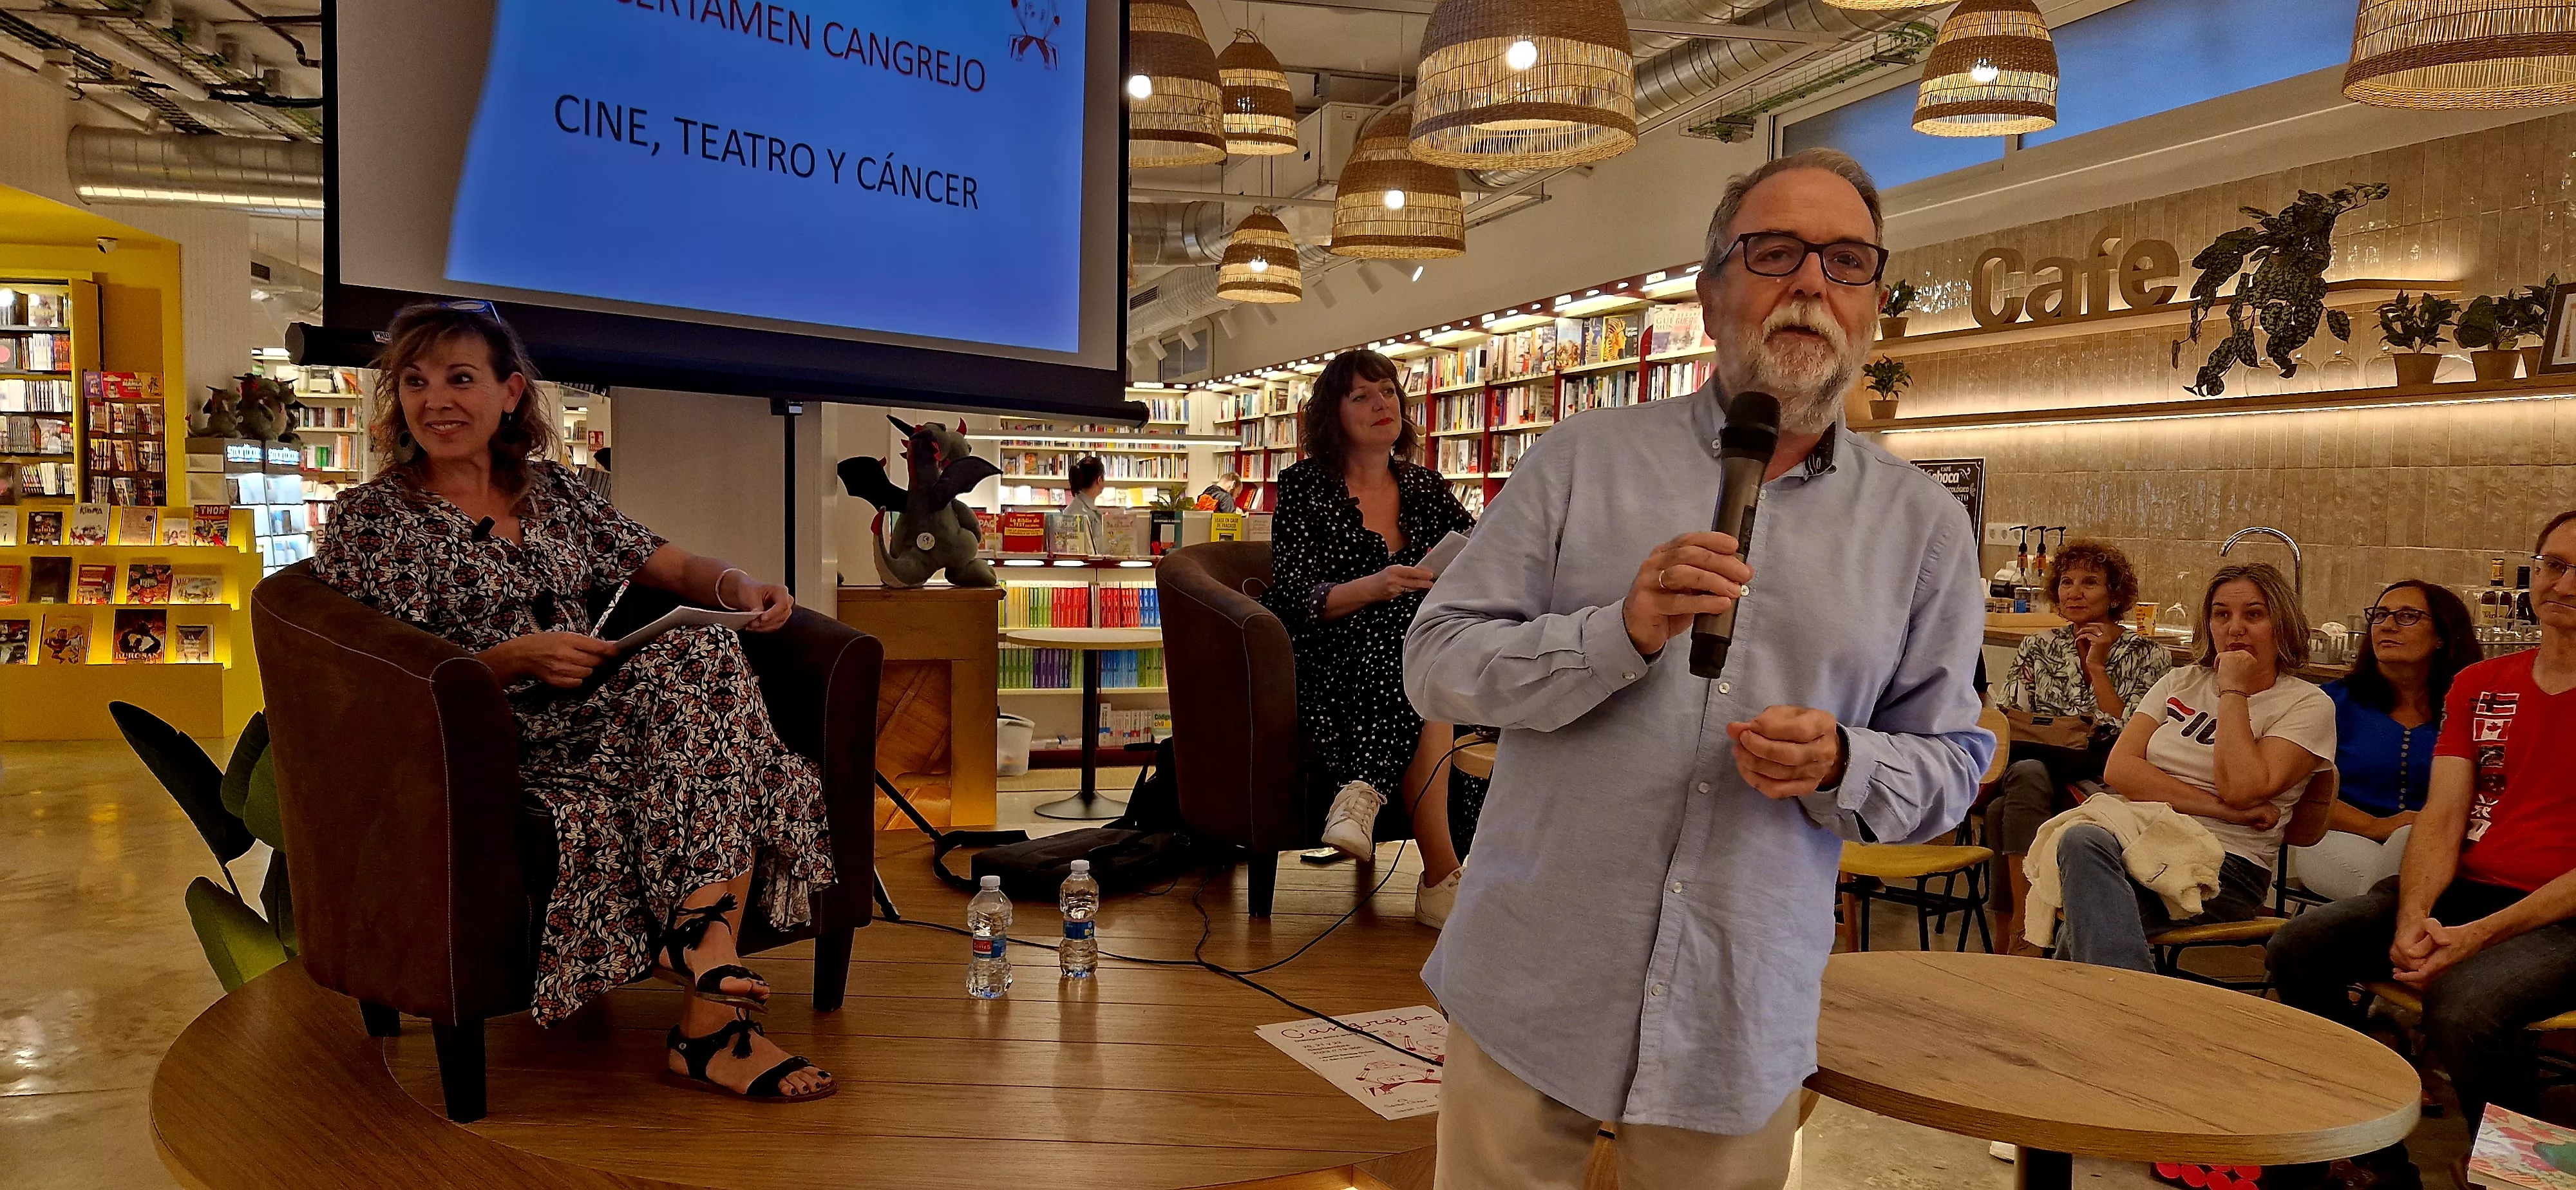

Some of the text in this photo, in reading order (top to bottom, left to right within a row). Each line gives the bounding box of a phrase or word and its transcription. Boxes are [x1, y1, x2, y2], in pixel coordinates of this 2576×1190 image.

[824, 21, 987, 93] CANGREJO
[554, 93, 980, 210] CINE, TEATRO Y CÁNCER
[1972, 224, 2180, 327] Cafe
[200, 505, 227, 515] THOR
[1281, 1015, 1432, 1039] Cangrejo
